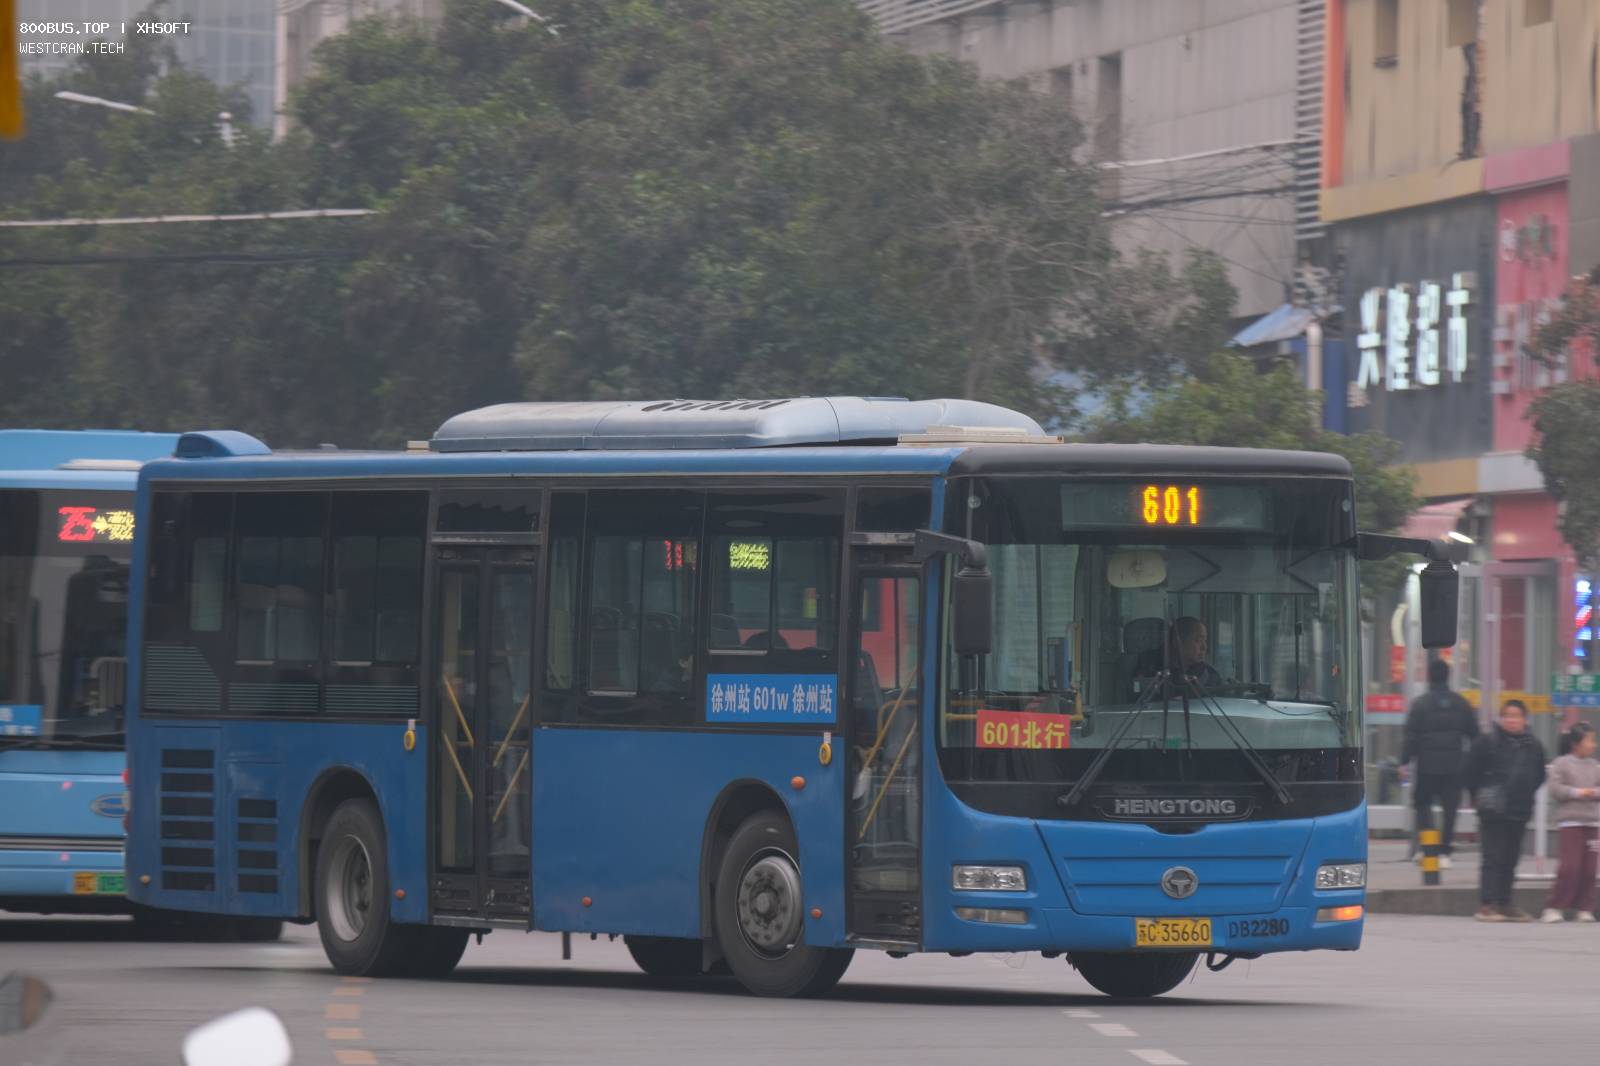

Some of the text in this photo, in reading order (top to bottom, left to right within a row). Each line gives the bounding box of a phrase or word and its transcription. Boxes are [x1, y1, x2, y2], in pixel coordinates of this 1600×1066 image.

[1143, 486, 1198, 524] 601
[711, 683, 832, 714] 徐州站 601w 徐州站
[982, 721, 1065, 748] 601北行
[1114, 799, 1236, 815] HENGTONG
[1229, 918, 1289, 937] DB2280
